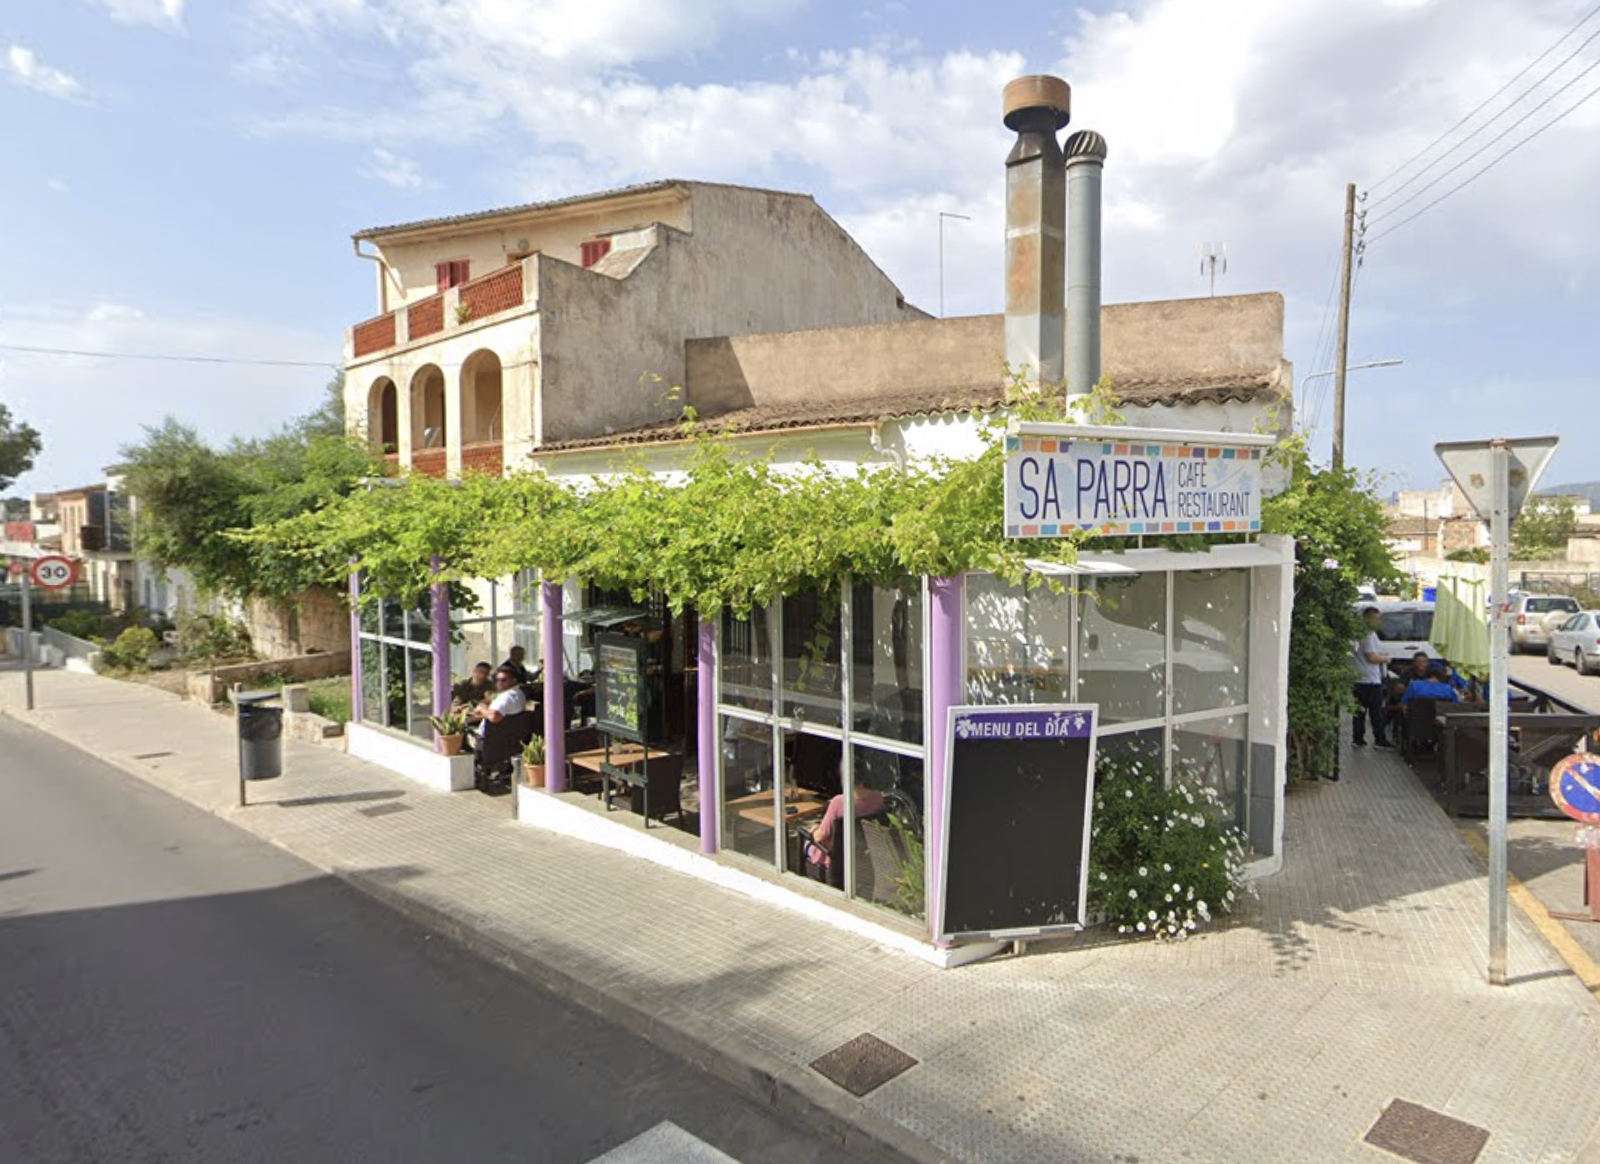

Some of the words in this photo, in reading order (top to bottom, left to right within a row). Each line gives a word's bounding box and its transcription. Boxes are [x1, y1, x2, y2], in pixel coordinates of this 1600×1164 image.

[1020, 457, 1061, 519] SA
[1077, 459, 1168, 519] PARRA
[1178, 491, 1250, 518] RESTAURANT
[41, 566, 67, 579] 30
[971, 722, 1011, 737] MENU
[1015, 722, 1040, 736] DEL
